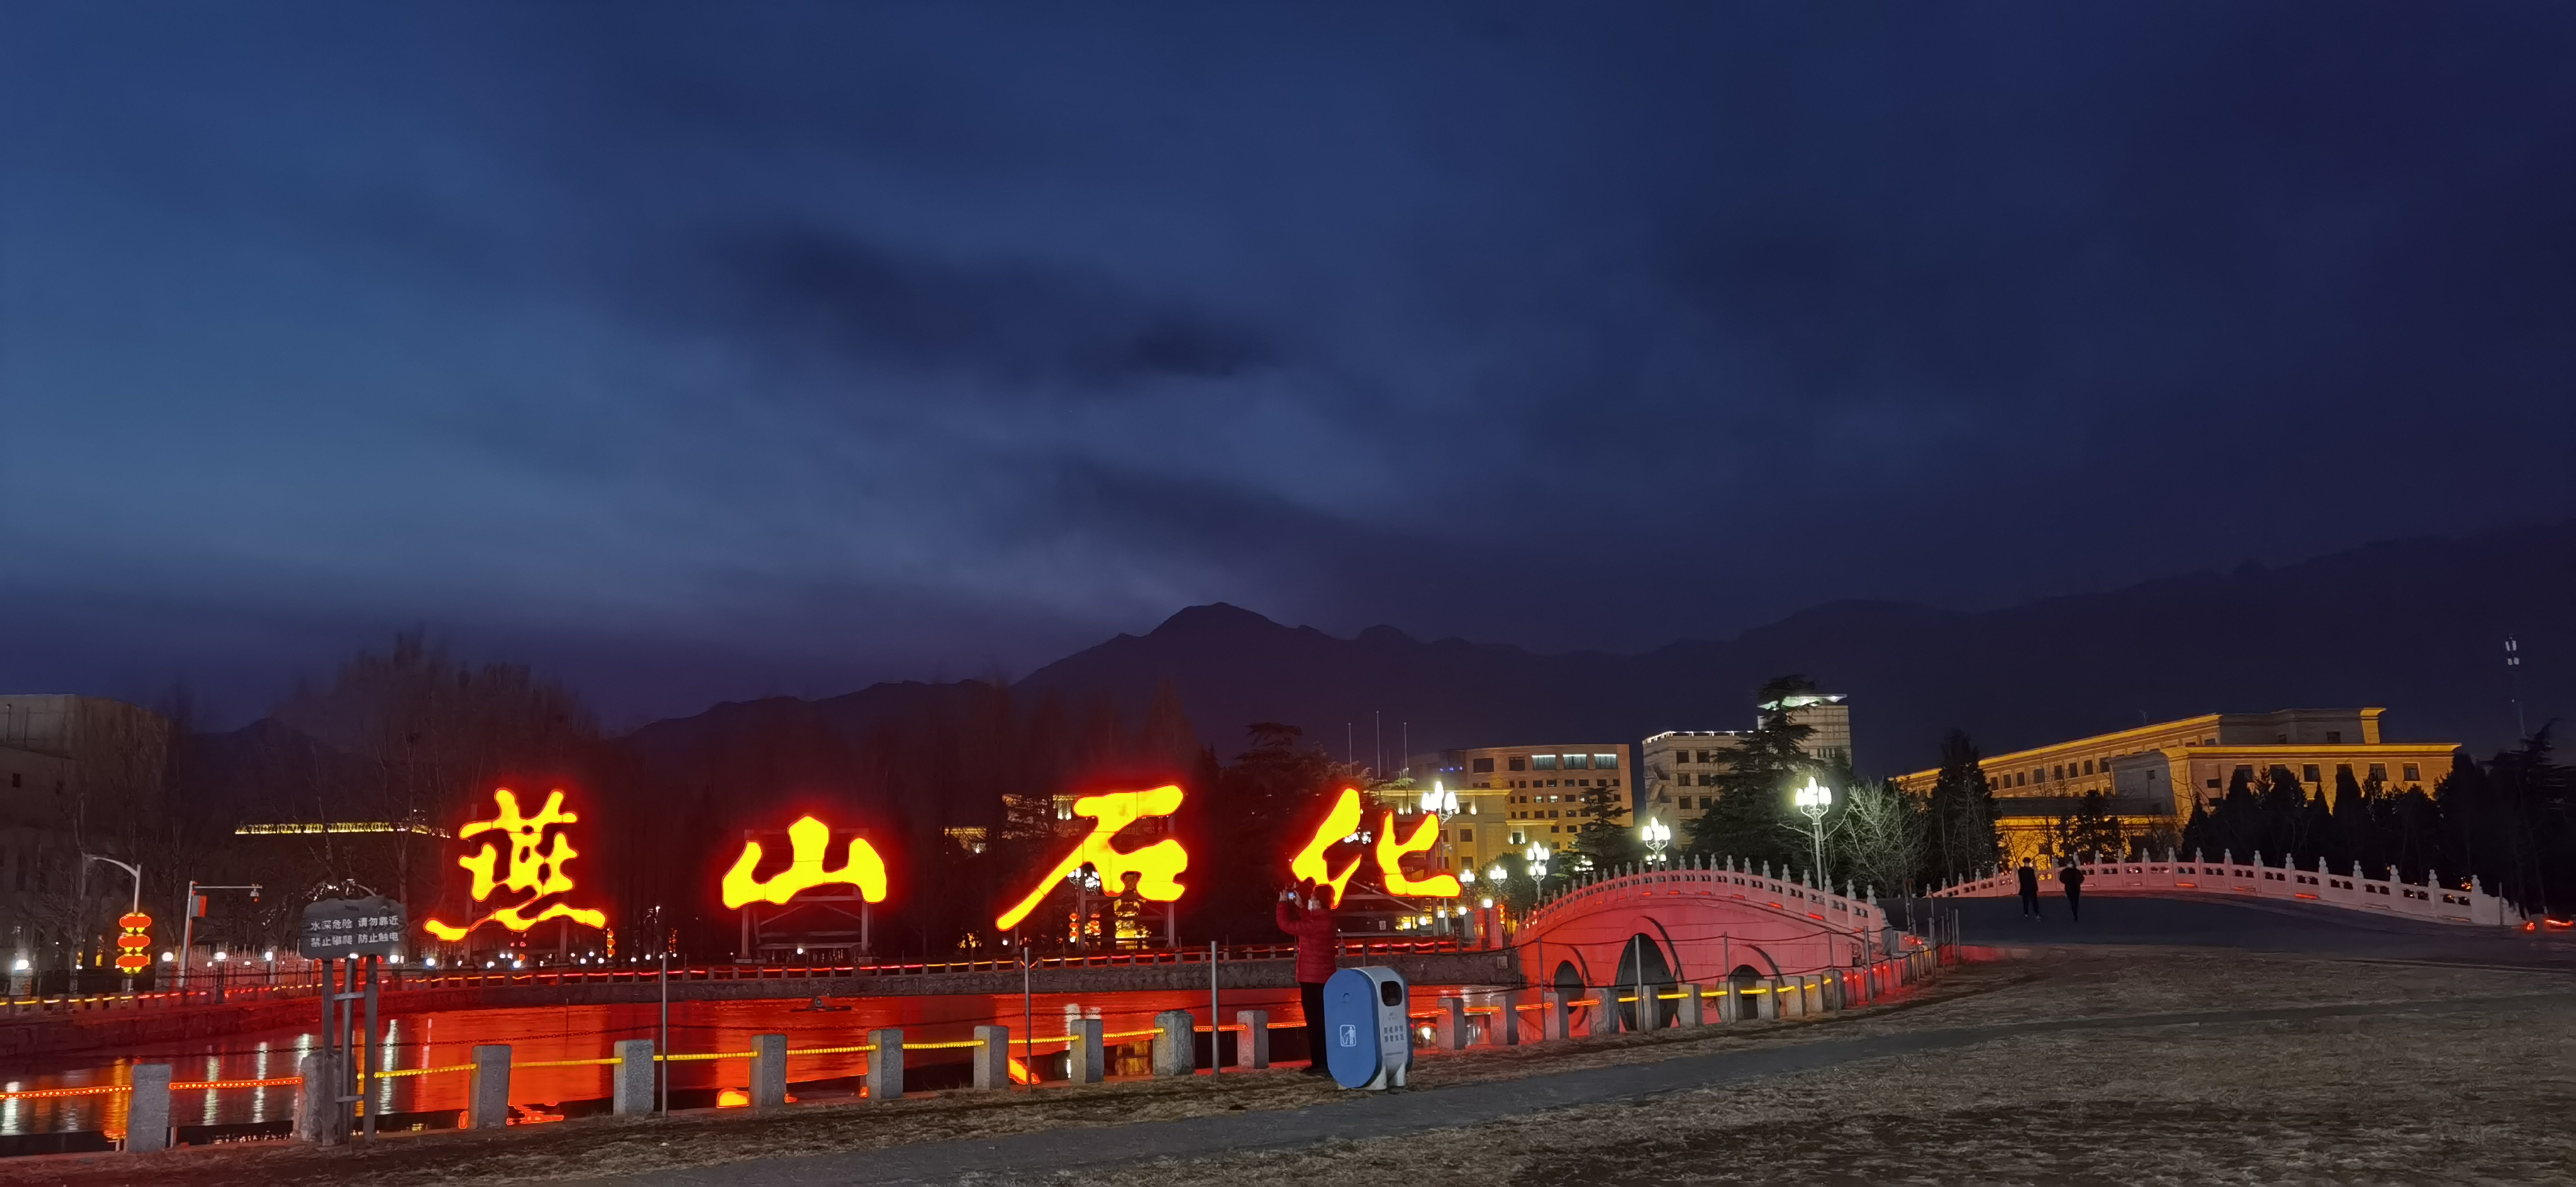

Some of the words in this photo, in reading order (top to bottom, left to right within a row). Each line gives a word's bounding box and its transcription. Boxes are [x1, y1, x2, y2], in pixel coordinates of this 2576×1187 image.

[424, 785, 1463, 942] 燕山石化
[311, 919, 353, 931] 水深危险
[358, 915, 399, 927] 请勿靠近
[311, 935, 353, 947] 禁止攀爬
[358, 932, 399, 944] 防止触电
